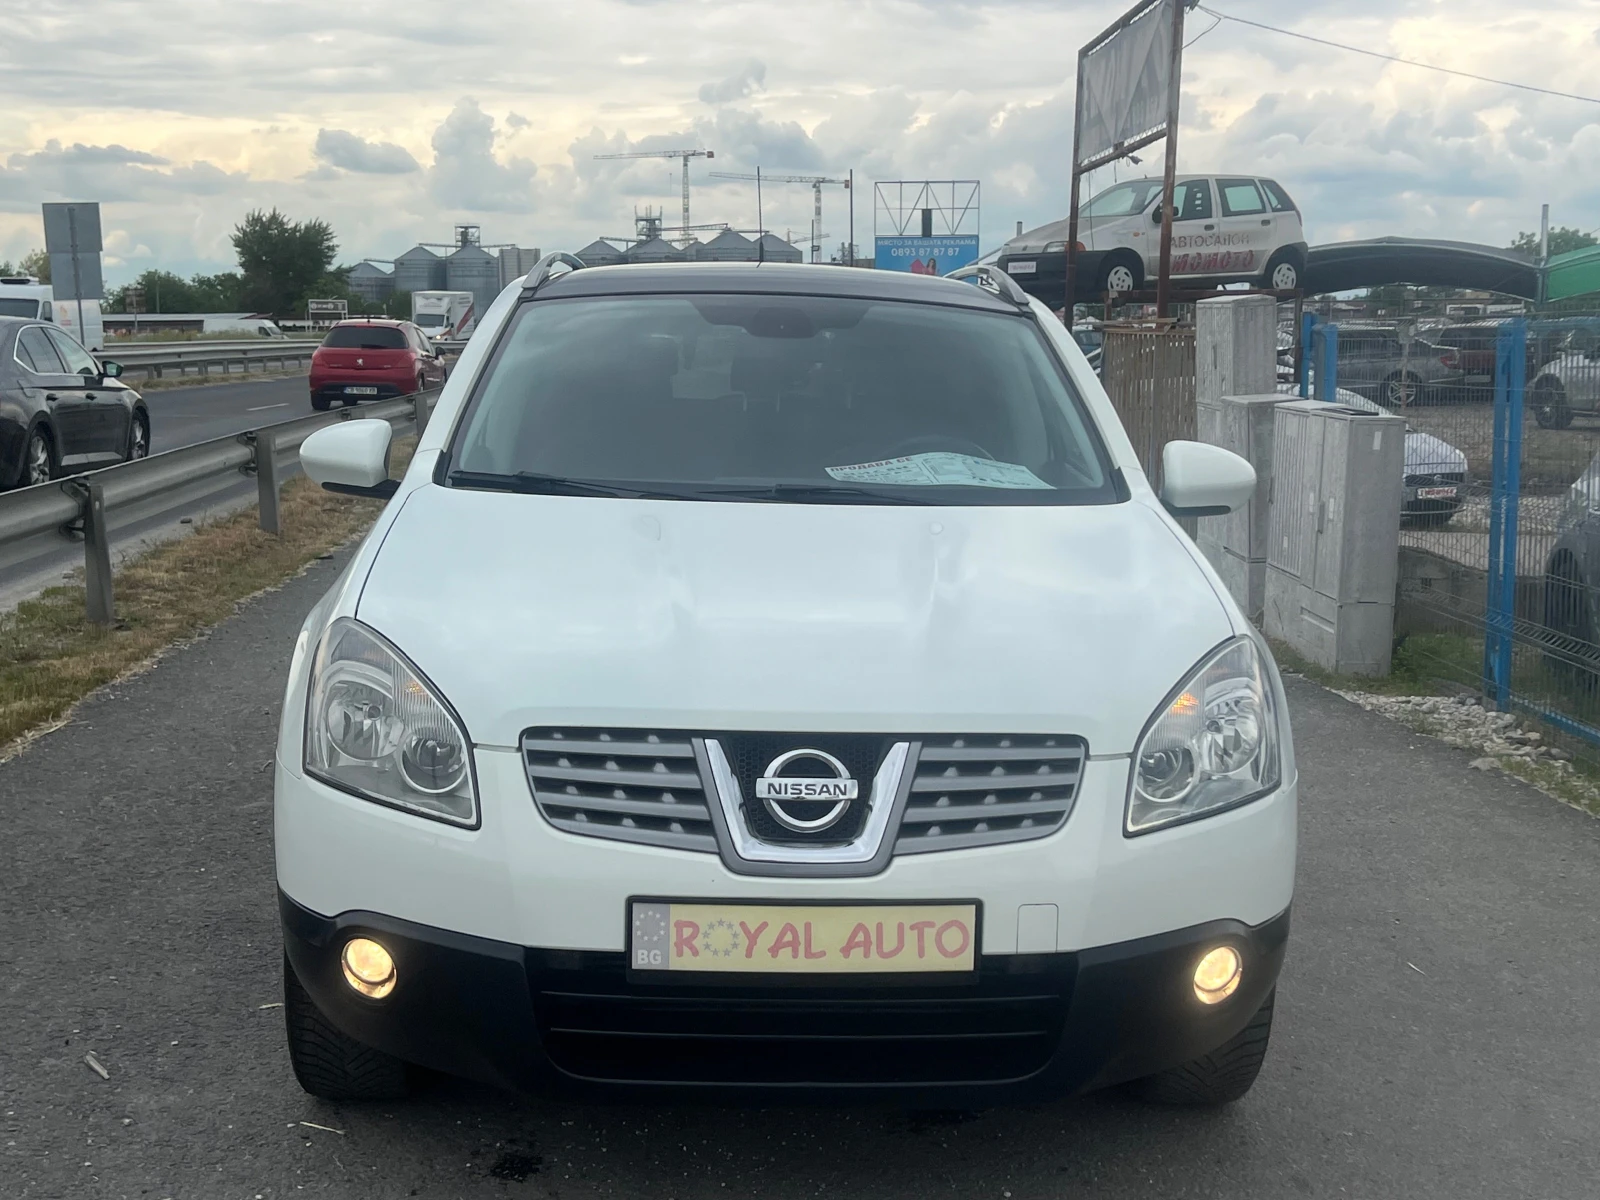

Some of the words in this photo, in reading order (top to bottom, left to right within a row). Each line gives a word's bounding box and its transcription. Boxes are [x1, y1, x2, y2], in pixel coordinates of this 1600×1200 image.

[891, 247, 916, 257] 0893
[918, 247, 931, 257] 87
[933, 247, 945, 257] 87
[947, 247, 960, 256] 87
[830, 459, 894, 472] ПРОДАВА
[896, 456, 913, 464] СЕ
[767, 782, 848, 796] NISSAN
[839, 918, 970, 960] AUTO
[637, 949, 662, 965] BG
